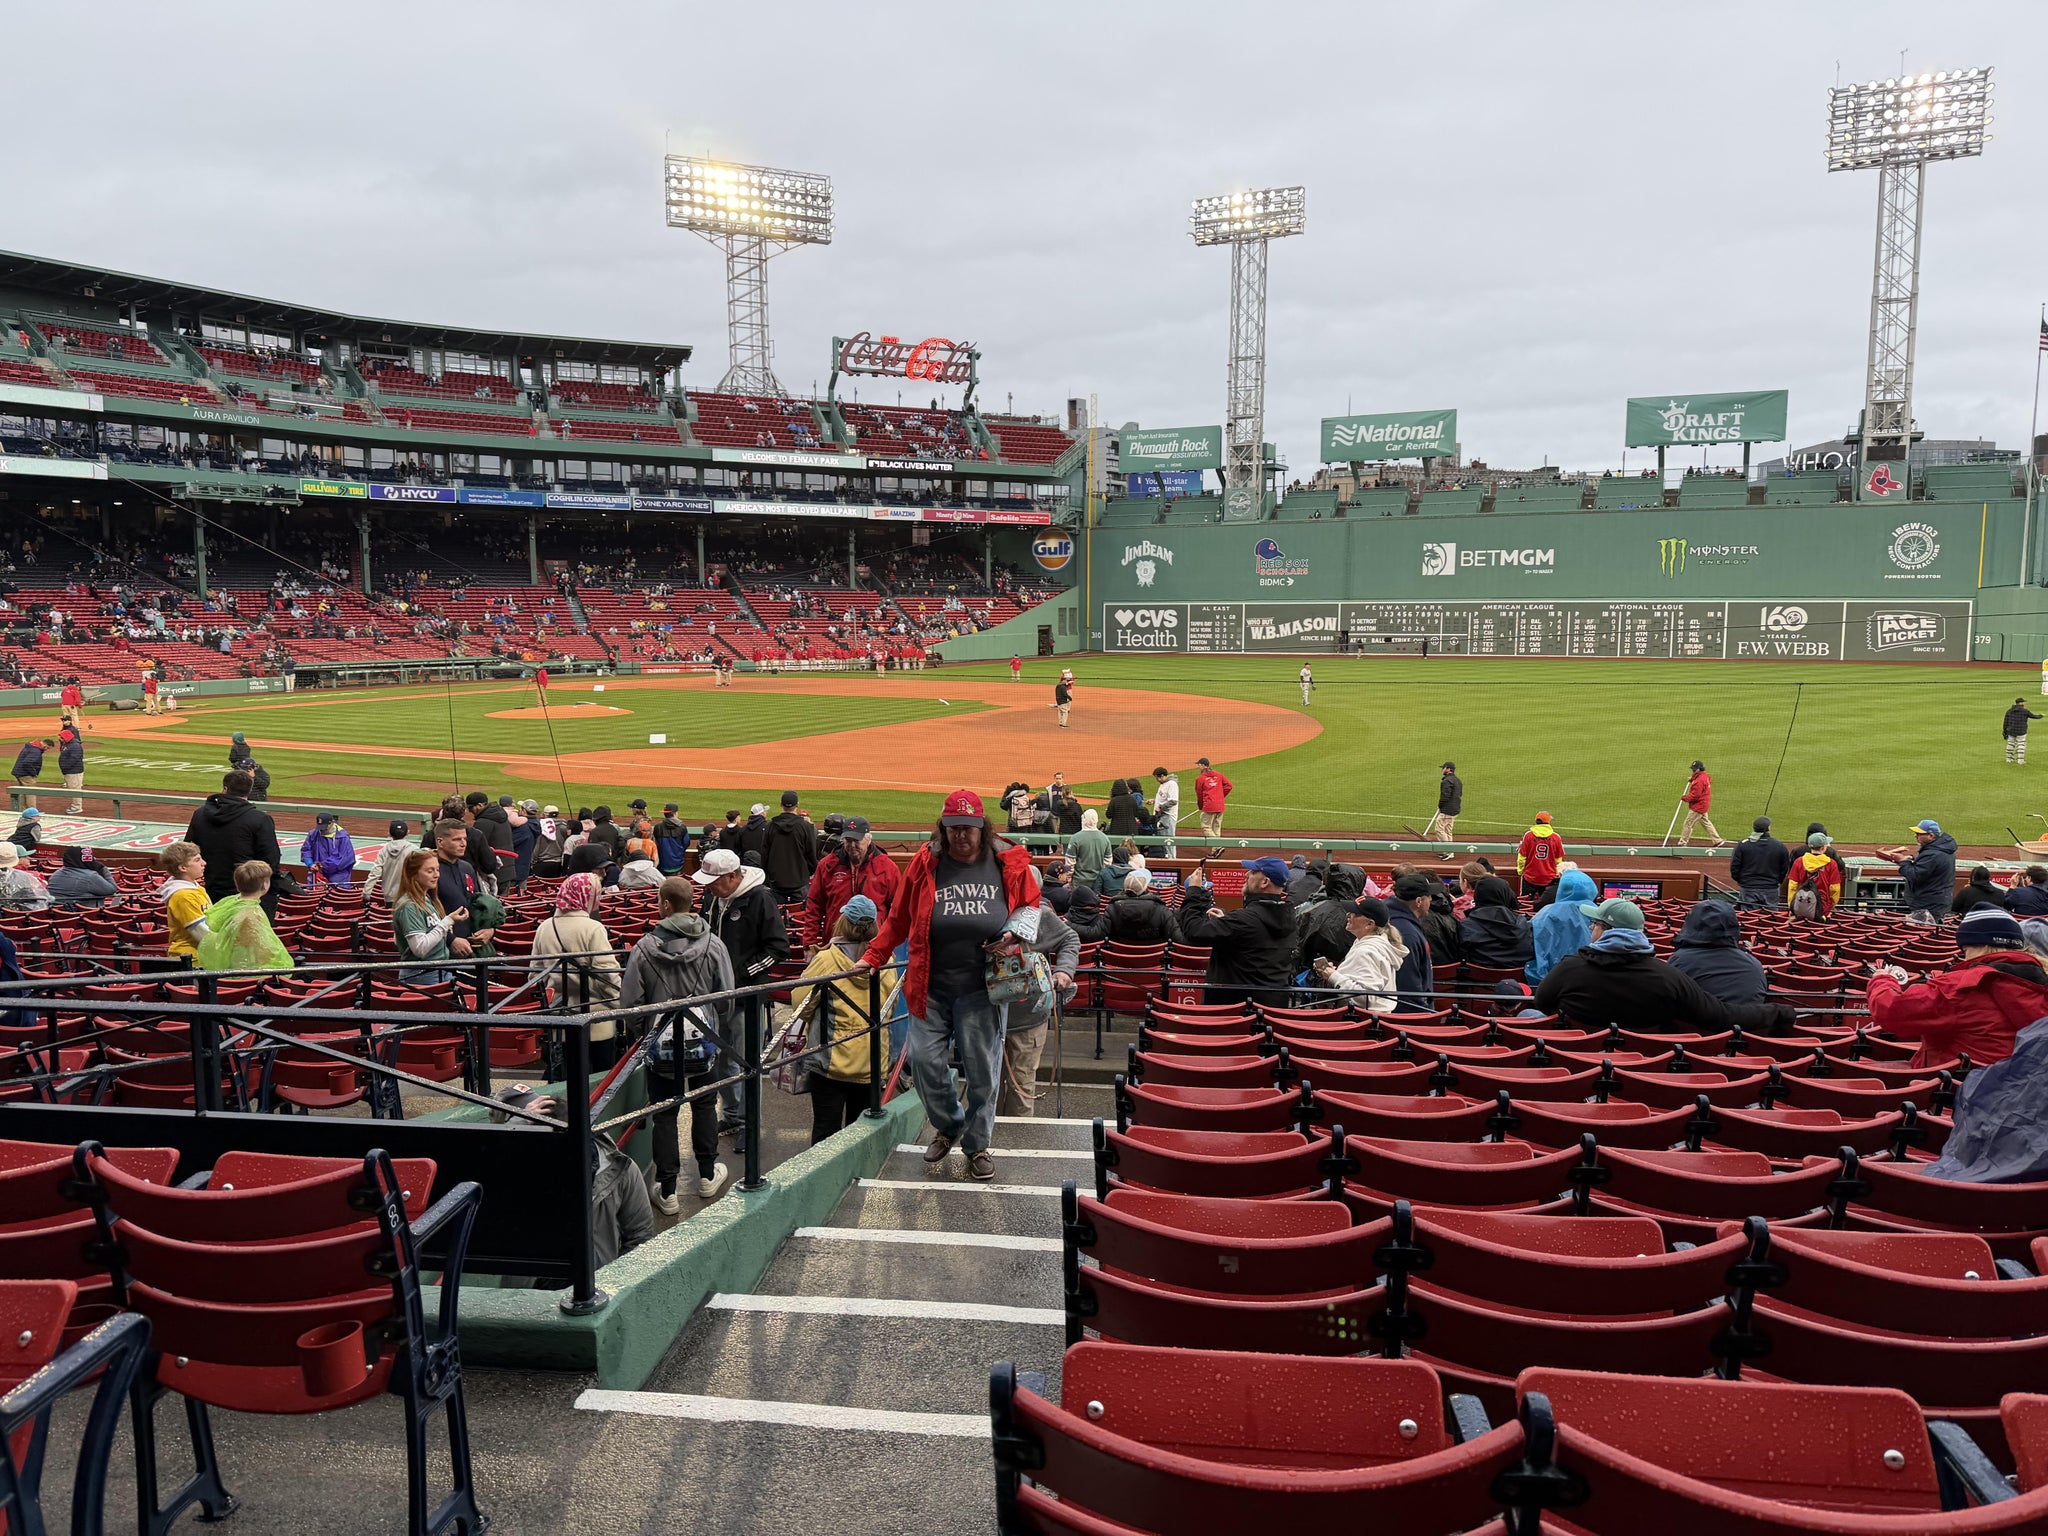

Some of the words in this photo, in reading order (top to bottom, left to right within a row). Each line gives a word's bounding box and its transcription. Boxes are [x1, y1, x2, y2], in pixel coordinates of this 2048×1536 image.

[840, 331, 977, 383] Coca-Cola
[222, 413, 260, 425] PAVILION
[1663, 412, 1745, 431] DRAFT
[1672, 426, 1741, 442] KINGS
[1129, 439, 1178, 455] Plymouth
[1181, 438, 1209, 452] Rock
[1385, 443, 1403, 452] Car
[1405, 441, 1439, 450] Rental
[742, 453, 777, 463] WELCOME
[778, 455, 787, 463] TO
[789, 455, 819, 465] FENWAY
[820, 456, 839, 466] PARK
[880, 460, 903, 469] BLACK
[904, 461, 924, 470] LIVES
[925, 462, 953, 471] MATTER
[1164, 477, 1188, 485] all-star
[303, 482, 338, 493] SULLIVAN
[348, 487, 364, 496] TIRE
[402, 488, 438, 500] HYCU
[583, 496, 629, 504] COMPANIES
[726, 503, 764, 512] AMERICA'S
[766, 504, 785, 513] MOST
[787, 505, 819, 514] BELOVED
[820, 506, 858, 516] BALLPARK
[936, 511, 953, 519] Ninety
[990, 514, 1020, 522] Safelite
[1891, 522, 1921, 538] IBEW
[1921, 523, 1938, 538] 103
[1034, 541, 1072, 555] Gulf
[1121, 545, 1143, 566] JIM
[1142, 540, 1174, 566] BEAM
[1260, 559, 1283, 568] RED
[1286, 559, 1309, 568] SOX
[1460, 549, 1554, 567] BETMGM
[1887, 545, 1897, 563] NECA
[1896, 544, 1941, 570] CONTRACTORS
[1260, 568, 1309, 576] SCHOLARS
[1259, 578, 1285, 586] BIDMC
[1135, 609, 1178, 628] CVS
[1882, 614, 1937, 631] ACE
[1116, 629, 1178, 647] Health
[1882, 630, 1937, 643] TICKET
[1974, 635, 1991, 644] 379
[1737, 642, 1768, 655] F.W.
[1774, 641, 1829, 656] WEBB
[171, 686, 195, 695] TICKET
[1535, 843, 1549, 860] 9
[934, 883, 999, 903] FENWAY
[943, 900, 989, 915] PARK
